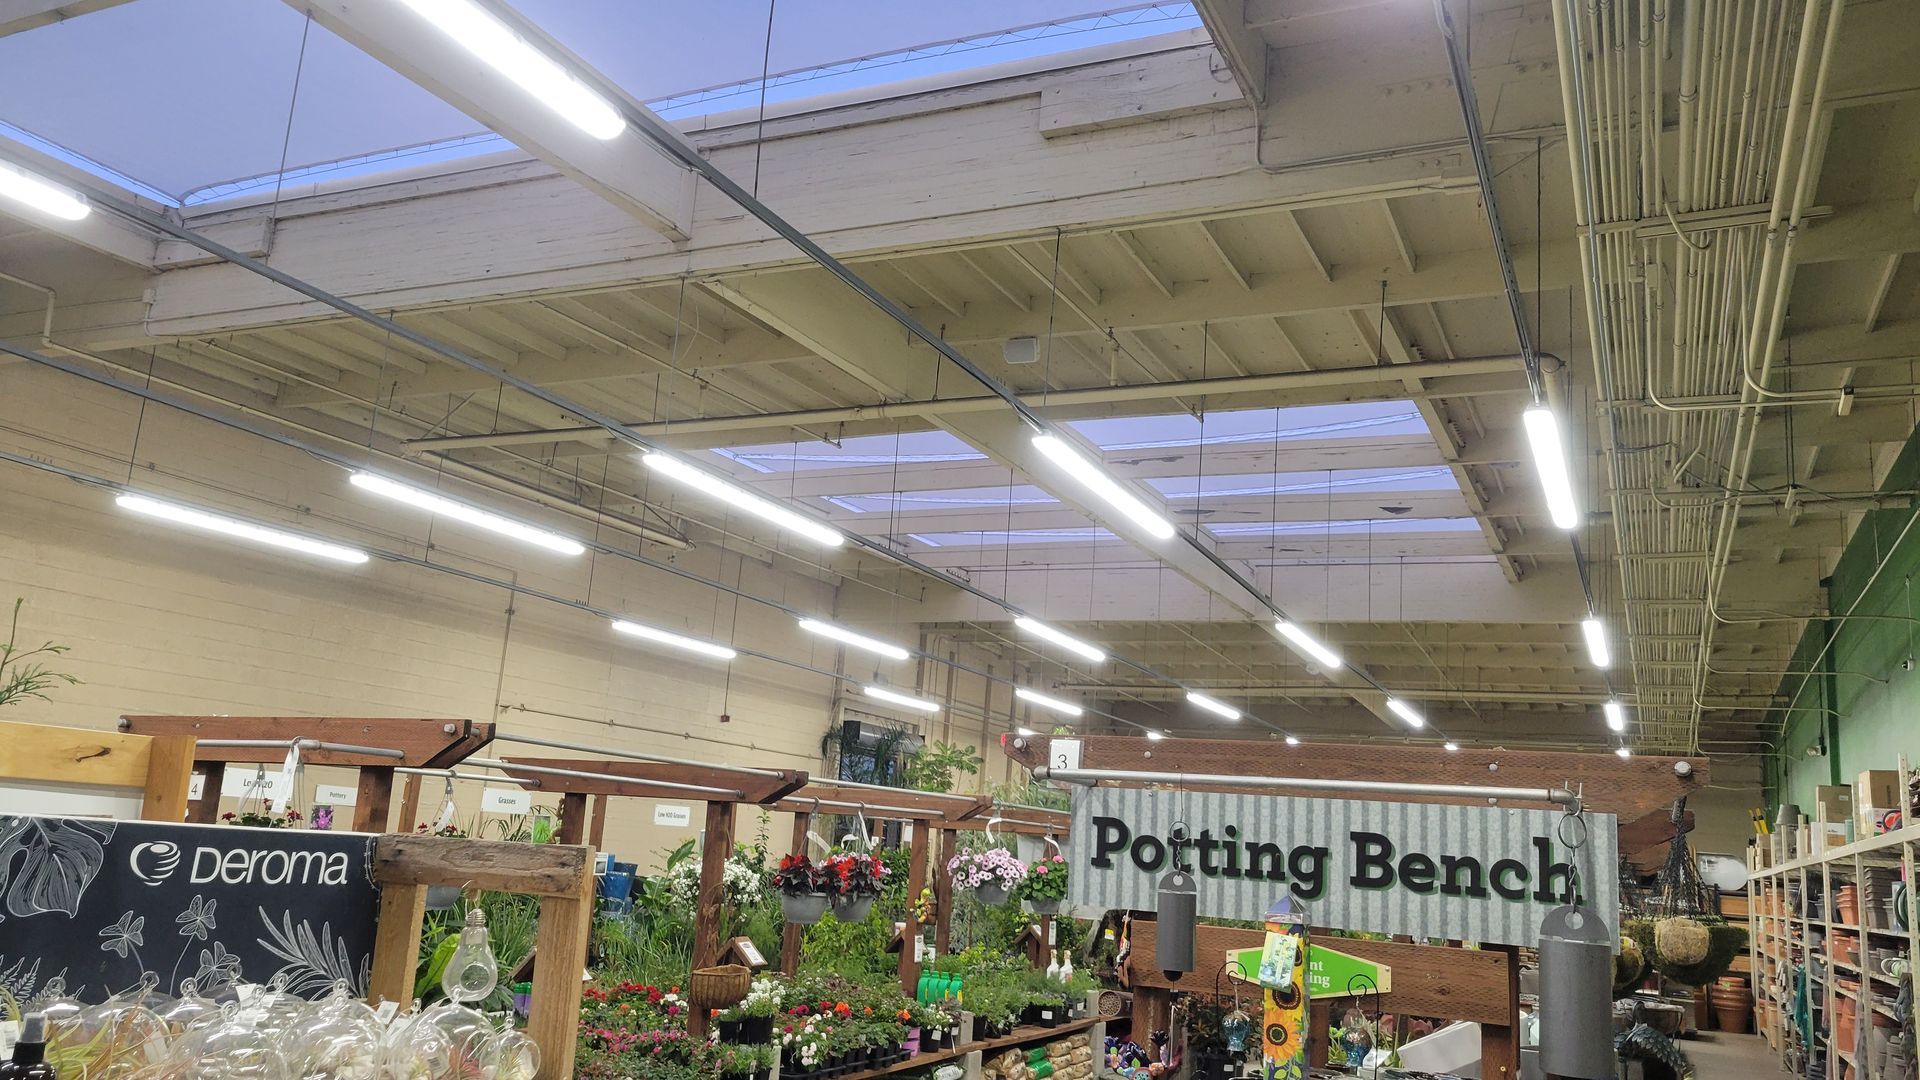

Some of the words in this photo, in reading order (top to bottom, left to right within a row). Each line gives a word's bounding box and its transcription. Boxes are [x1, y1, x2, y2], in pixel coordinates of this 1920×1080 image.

[1057, 753, 1068, 769] 3
[190, 783, 198, 796] 4
[329, 791, 346, 799] Pottery
[498, 796, 516, 804] Grasses
[190, 846, 348, 885] Deroma
[1091, 816, 1330, 898] Potting
[1350, 831, 1583, 905] Bench
